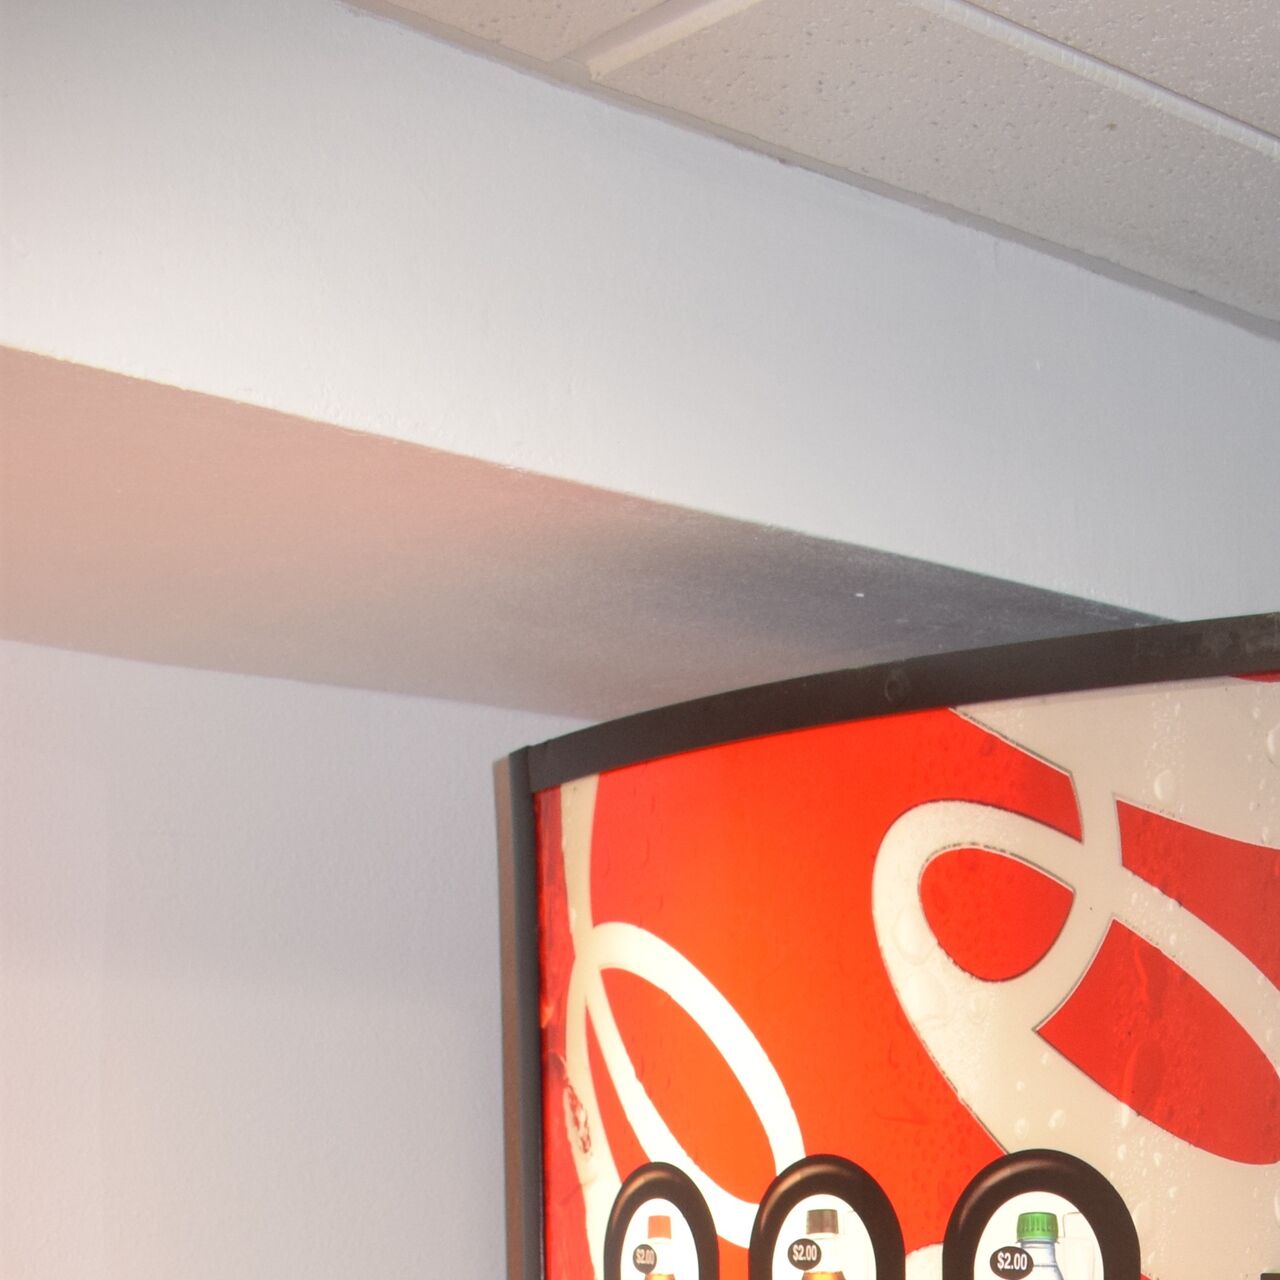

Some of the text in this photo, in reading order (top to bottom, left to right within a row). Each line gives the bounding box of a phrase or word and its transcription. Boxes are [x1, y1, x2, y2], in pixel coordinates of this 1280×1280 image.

[635, 1249, 655, 1266] $2.00
[793, 1244, 817, 1262] $2.00
[997, 1251, 1028, 1271] $2.00
